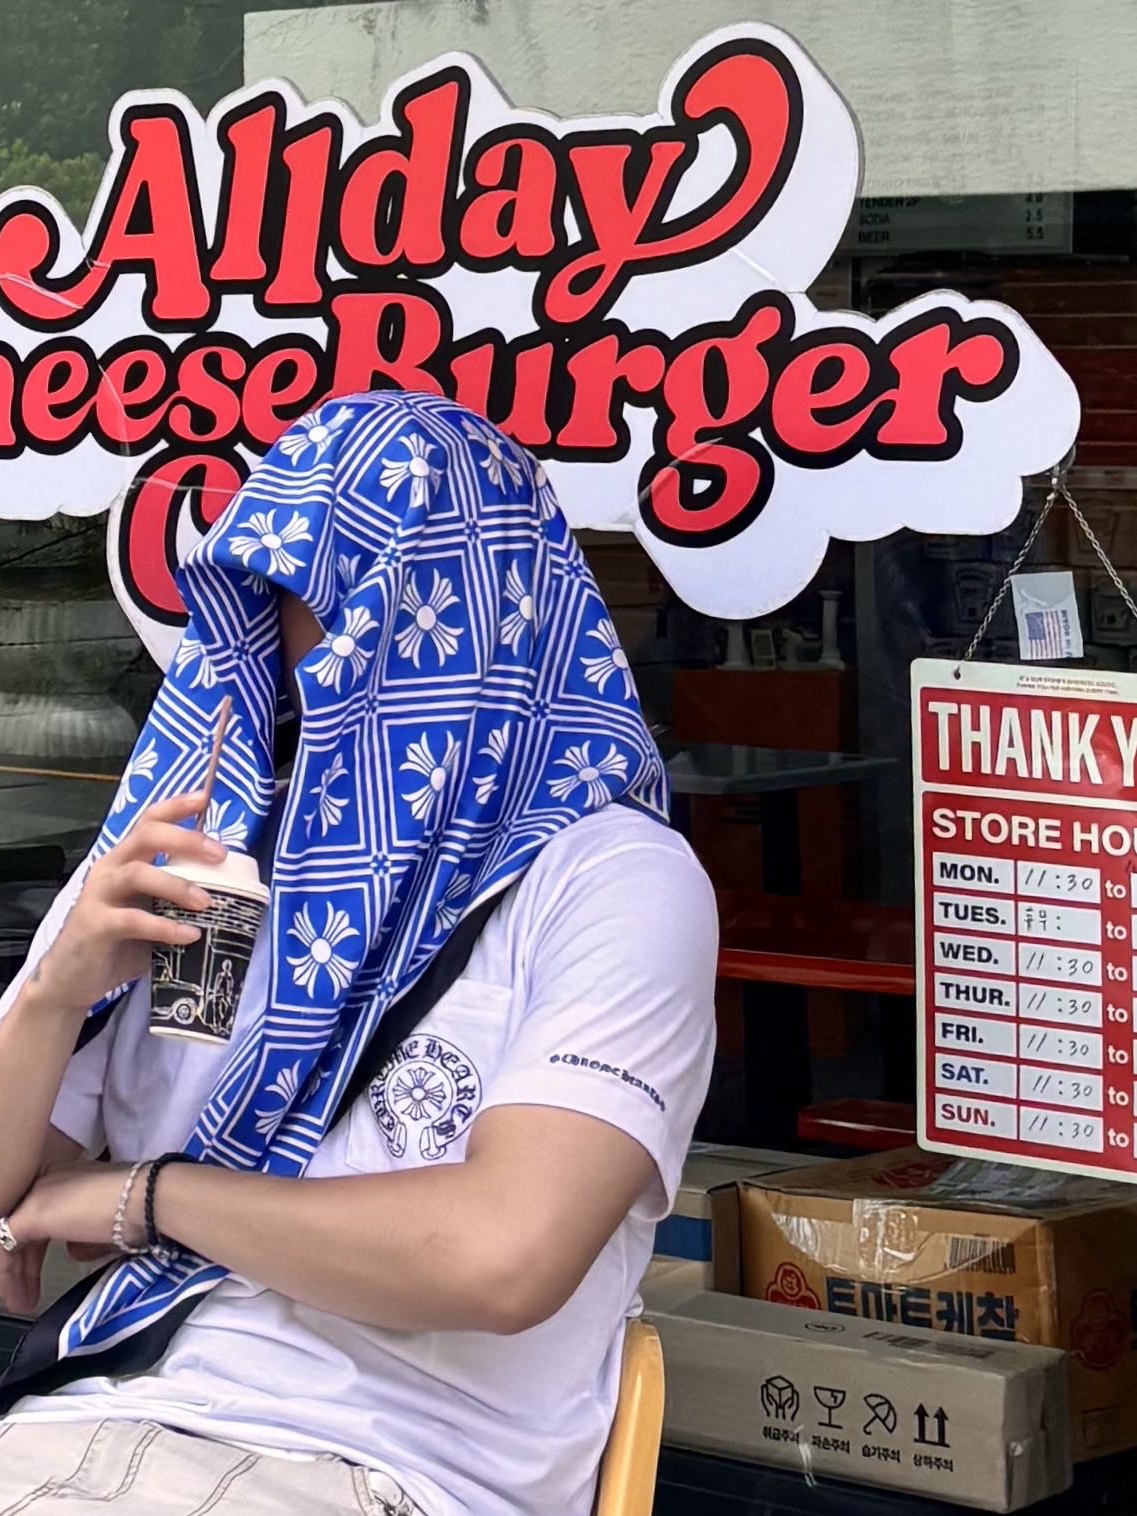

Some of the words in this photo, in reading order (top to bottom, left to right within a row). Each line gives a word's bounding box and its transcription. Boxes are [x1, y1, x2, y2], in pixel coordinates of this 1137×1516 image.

[928, 701, 1104, 785] THANK
[932, 808, 1062, 850] STORE
[1072, 821, 1137, 857] HO
[939, 861, 1000, 884] MON.
[1105, 879, 1127, 899] to
[938, 901, 1007, 925] TUES.
[1105, 921, 1127, 940] to
[939, 941, 999, 965] WED.
[1106, 962, 1128, 981] to
[939, 981, 1011, 1007] THUR.
[1106, 1003, 1128, 1023] to
[941, 1022, 984, 1044] FRI.
[1107, 1045, 1129, 1064] to
[941, 1062, 989, 1085] SAT.
[1108, 1086, 1129, 1106] to
[941, 1103, 996, 1127] SUN.
[1108, 1128, 1130, 1147] to
